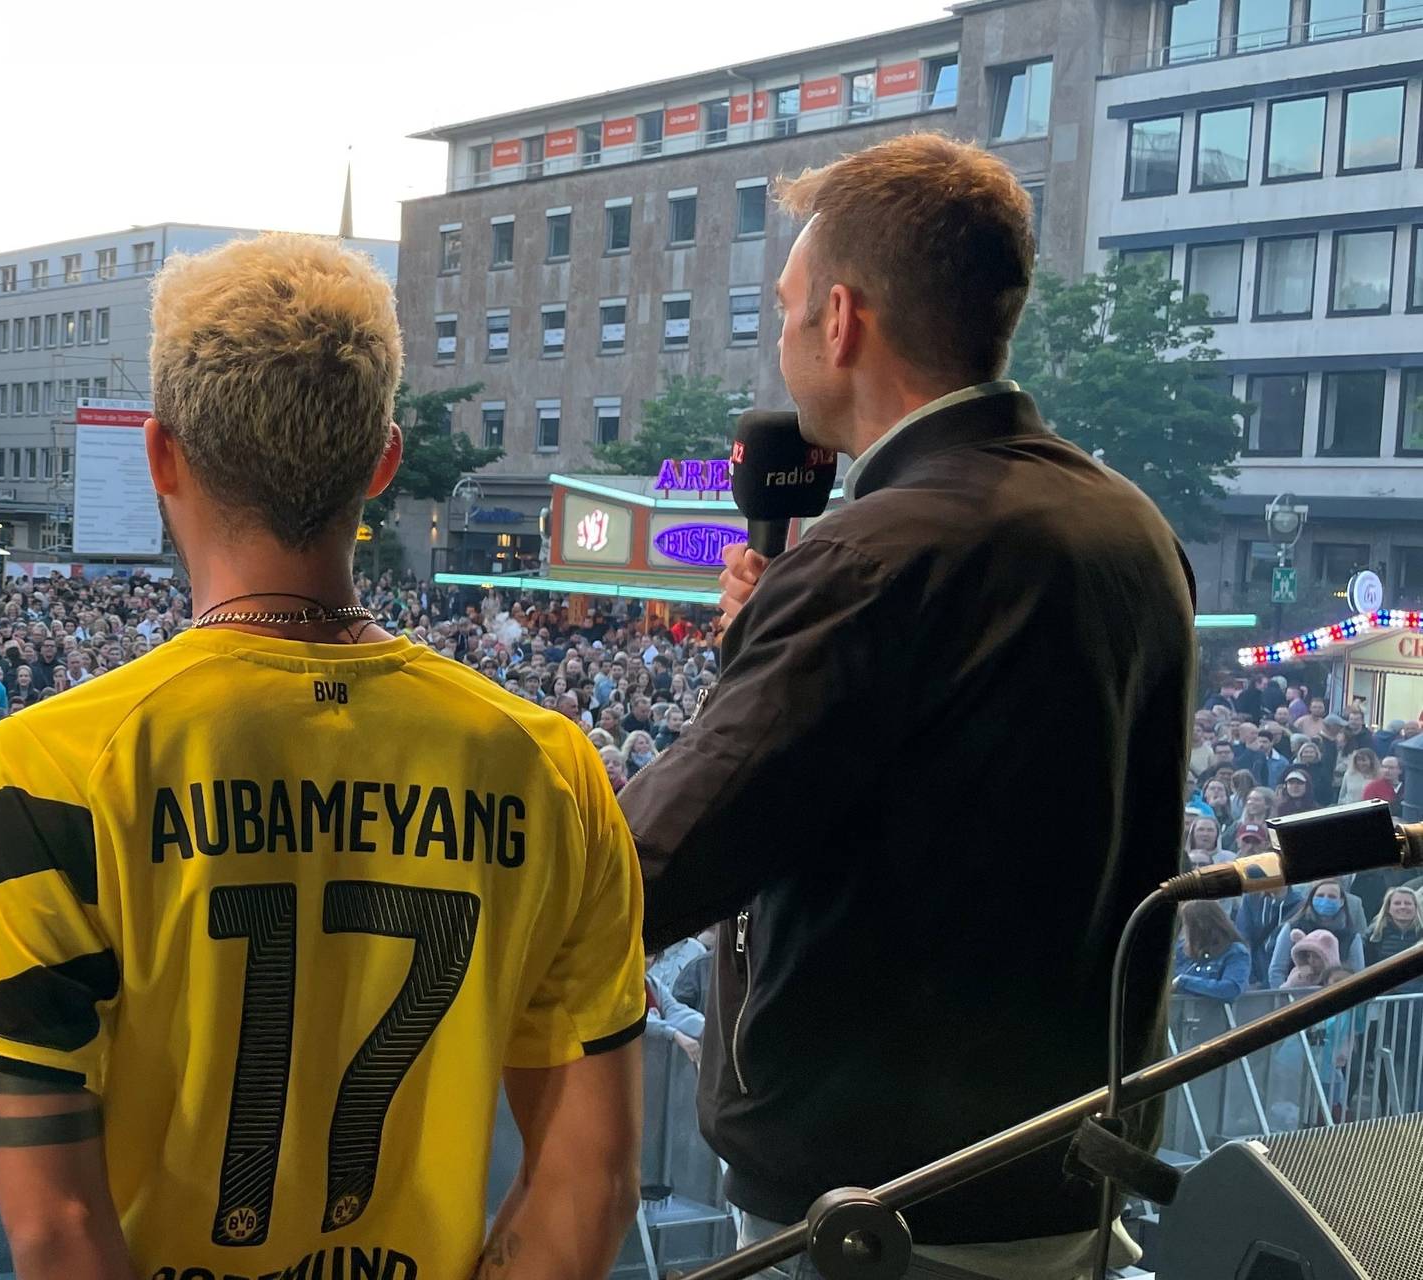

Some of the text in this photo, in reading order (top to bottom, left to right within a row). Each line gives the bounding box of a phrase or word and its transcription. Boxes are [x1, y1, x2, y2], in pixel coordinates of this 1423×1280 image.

[654, 458, 733, 491] ARE
[766, 466, 816, 487] radio
[313, 680, 348, 704] BVB
[151, 779, 526, 869] AUBAMEYANG
[208, 879, 481, 1247] 17
[228, 1209, 255, 1230] BVB
